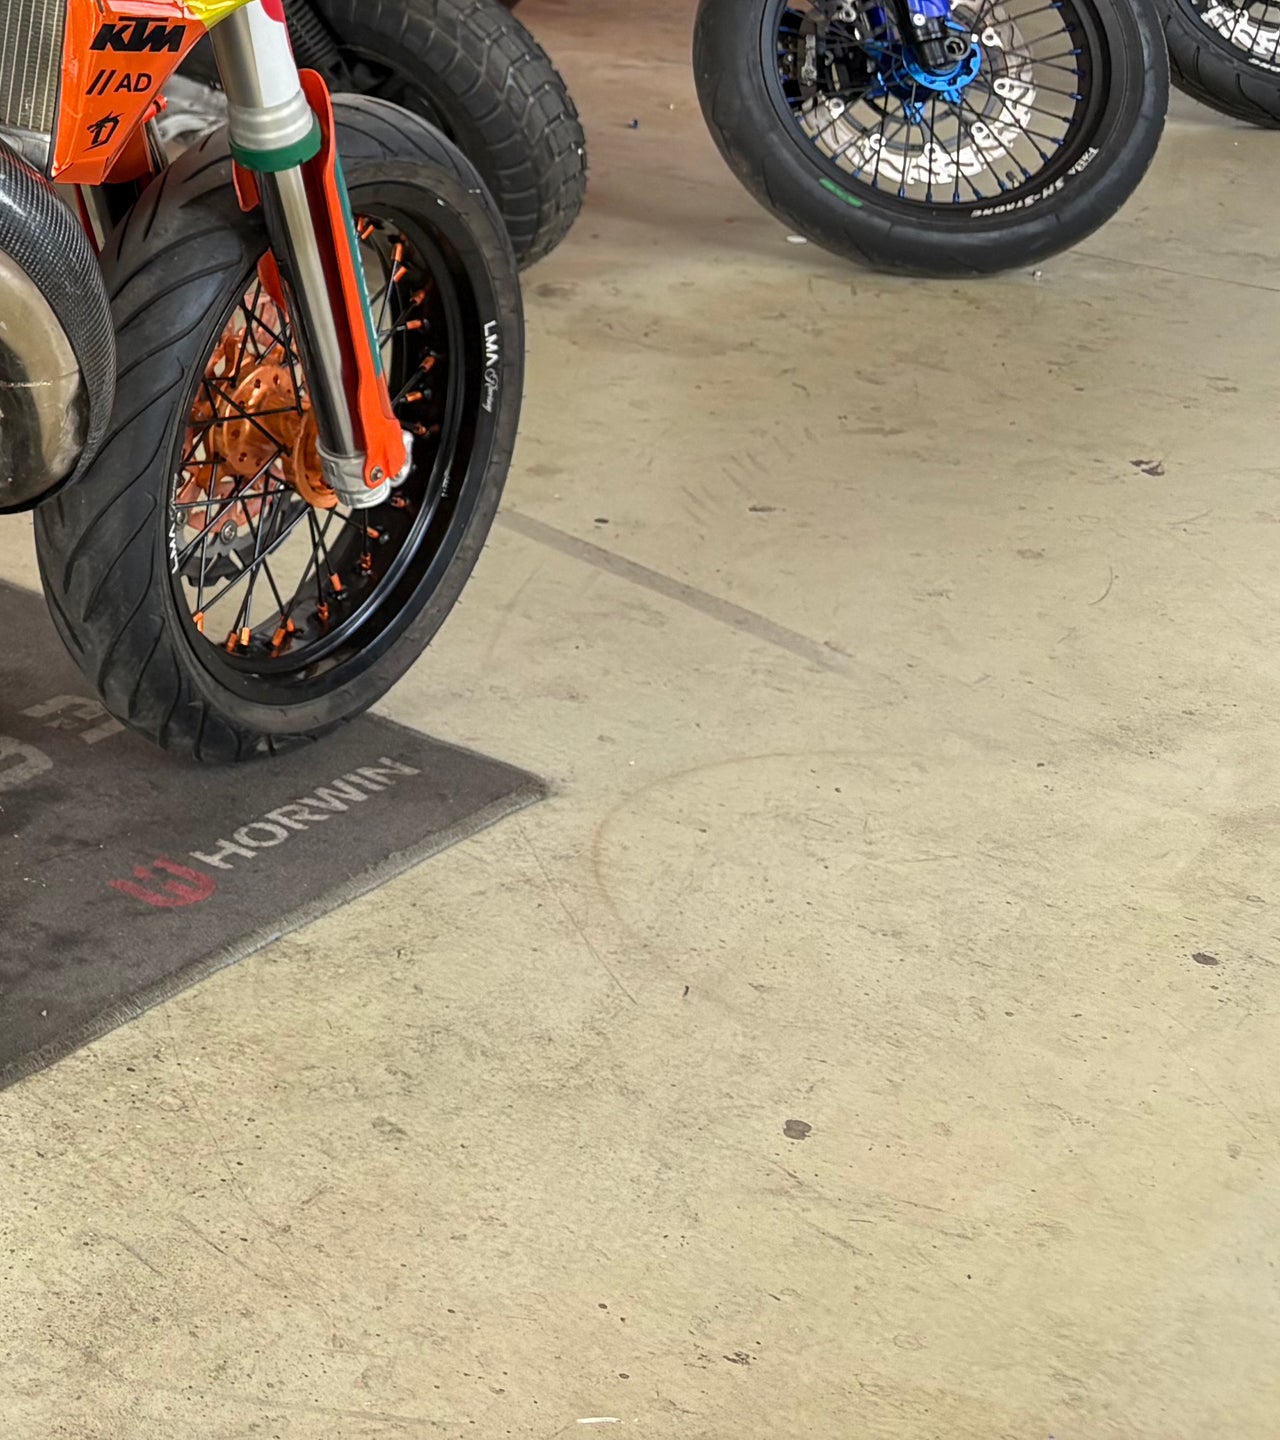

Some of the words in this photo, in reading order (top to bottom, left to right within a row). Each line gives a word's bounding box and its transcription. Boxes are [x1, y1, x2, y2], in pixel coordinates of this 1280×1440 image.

[90, 16, 186, 52] KTM
[483, 319, 499, 367] LMA
[190, 756, 422, 870] HORWIN
